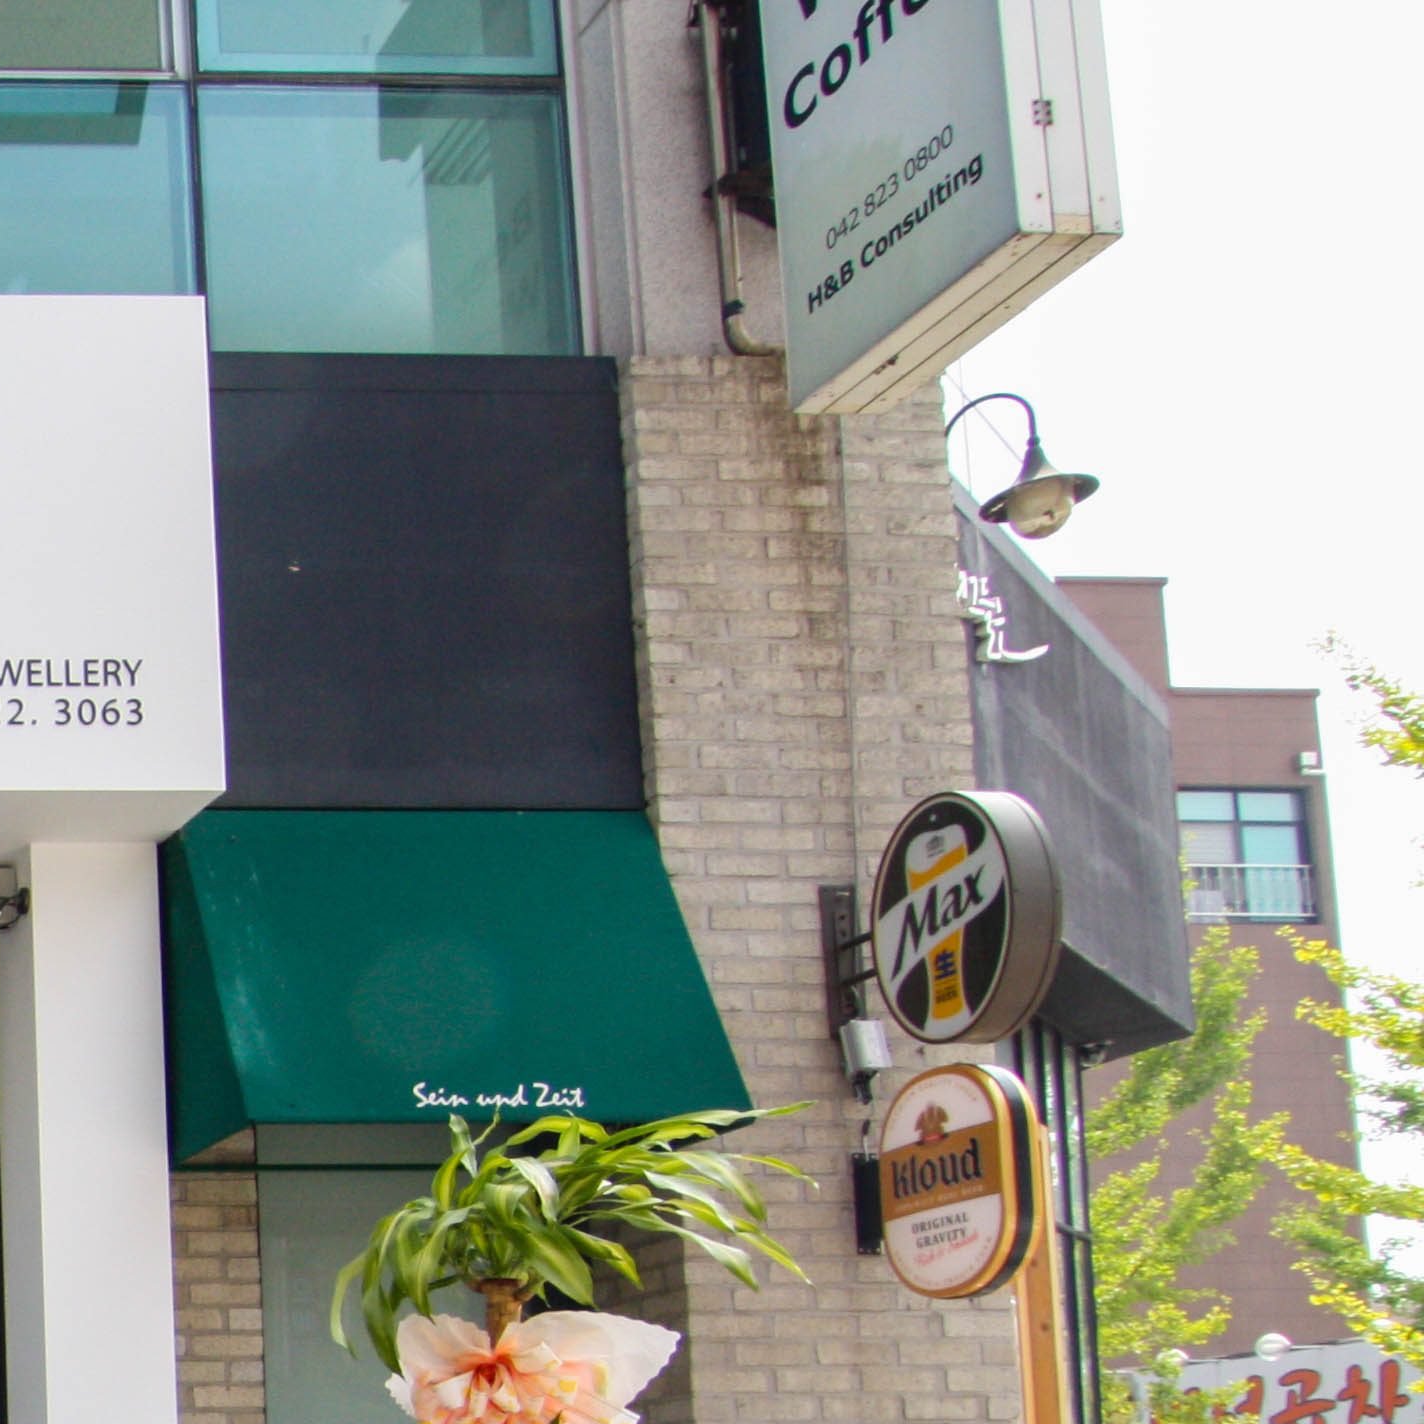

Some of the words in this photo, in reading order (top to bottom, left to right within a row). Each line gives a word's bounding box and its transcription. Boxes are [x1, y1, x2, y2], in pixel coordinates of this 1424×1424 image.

[784, 0, 930, 129] Coff
[825, 207, 859, 250] 042
[863, 172, 899, 218] 823
[903, 123, 954, 181] 0800
[807, 258, 854, 314] H&B
[860, 152, 985, 269] Consulting
[54, 698, 144, 726] 3063
[891, 863, 986, 983] Max
[413, 1081, 468, 1108] Sein
[475, 1084, 529, 1107] und
[533, 1082, 585, 1108] Zeit
[911, 1211, 969, 1235] ORIGINAL
[915, 1226, 967, 1249] GRAVITY
